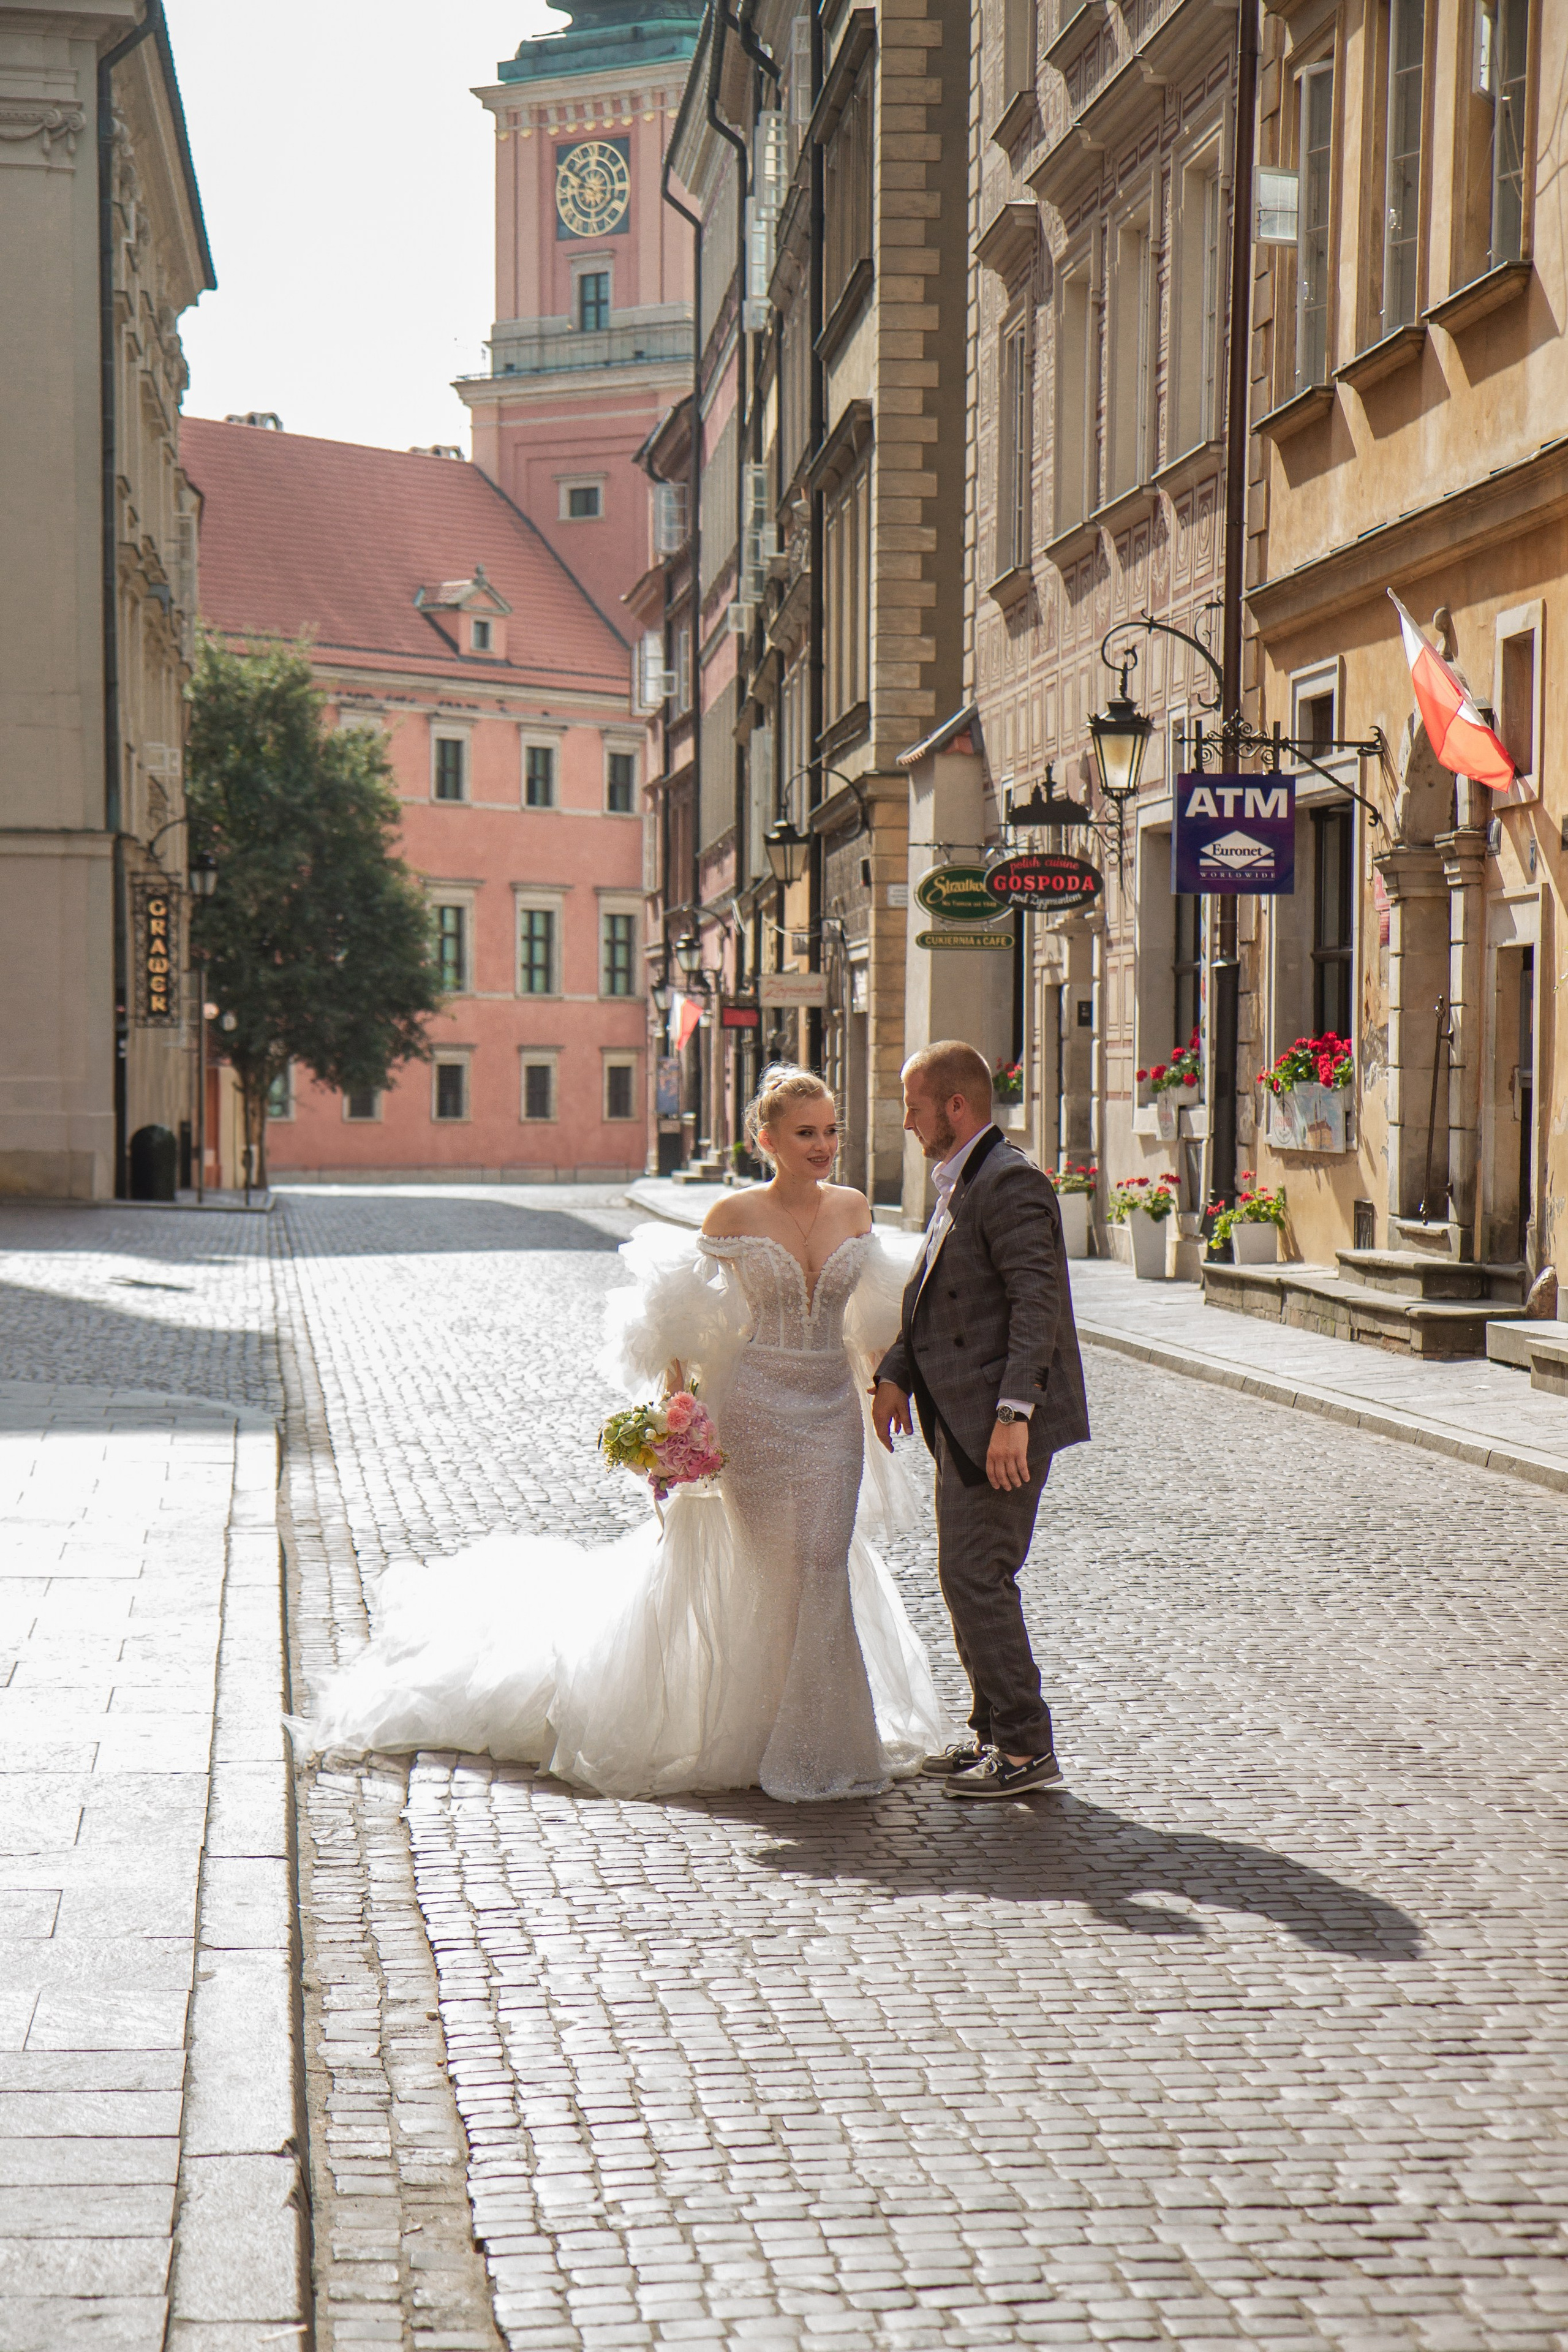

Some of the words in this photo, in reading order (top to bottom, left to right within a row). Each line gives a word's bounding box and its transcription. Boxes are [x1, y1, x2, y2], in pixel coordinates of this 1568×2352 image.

[1185, 787, 1288, 818] ATM
[1212, 843, 1262, 856] Euronet
[1044, 857, 1080, 870] cuisine
[993, 875, 1095, 891] GOSPODA
[925, 936, 974, 946] CUKIERNIA
